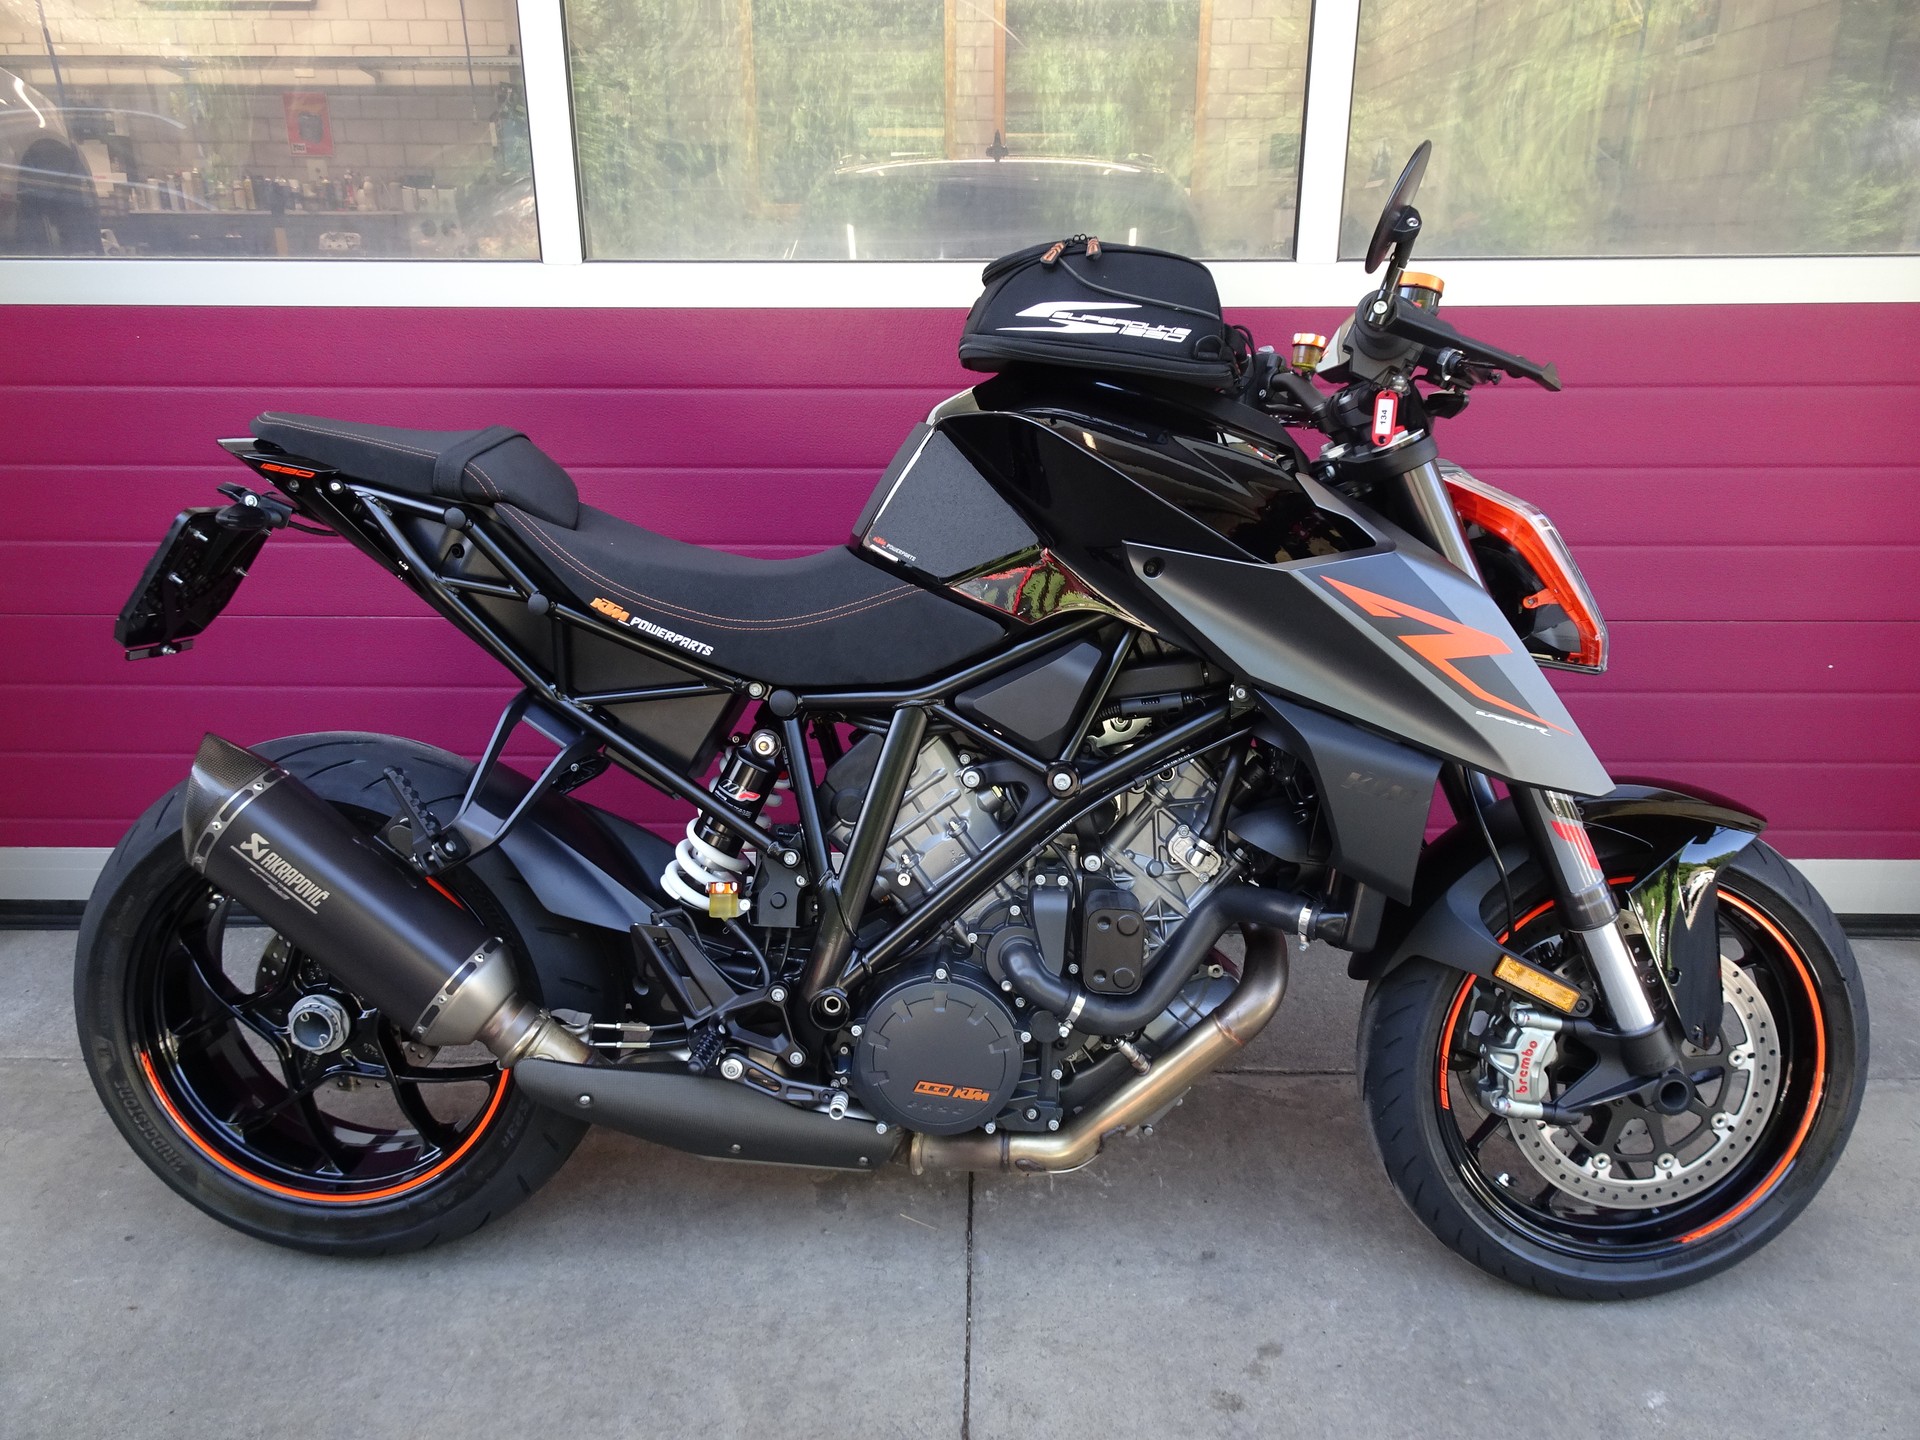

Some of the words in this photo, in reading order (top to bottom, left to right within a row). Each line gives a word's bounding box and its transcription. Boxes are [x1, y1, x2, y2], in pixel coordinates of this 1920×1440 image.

[1380, 409, 1388, 425] 134
[260, 462, 316, 478] 1290
[886, 543, 917, 562] POWERPARTS
[589, 597, 631, 622] KTM
[630, 616, 715, 656] POWERPARTS
[1515, 1040, 1538, 1094] brembo
[952, 1086, 991, 1102] KTM
